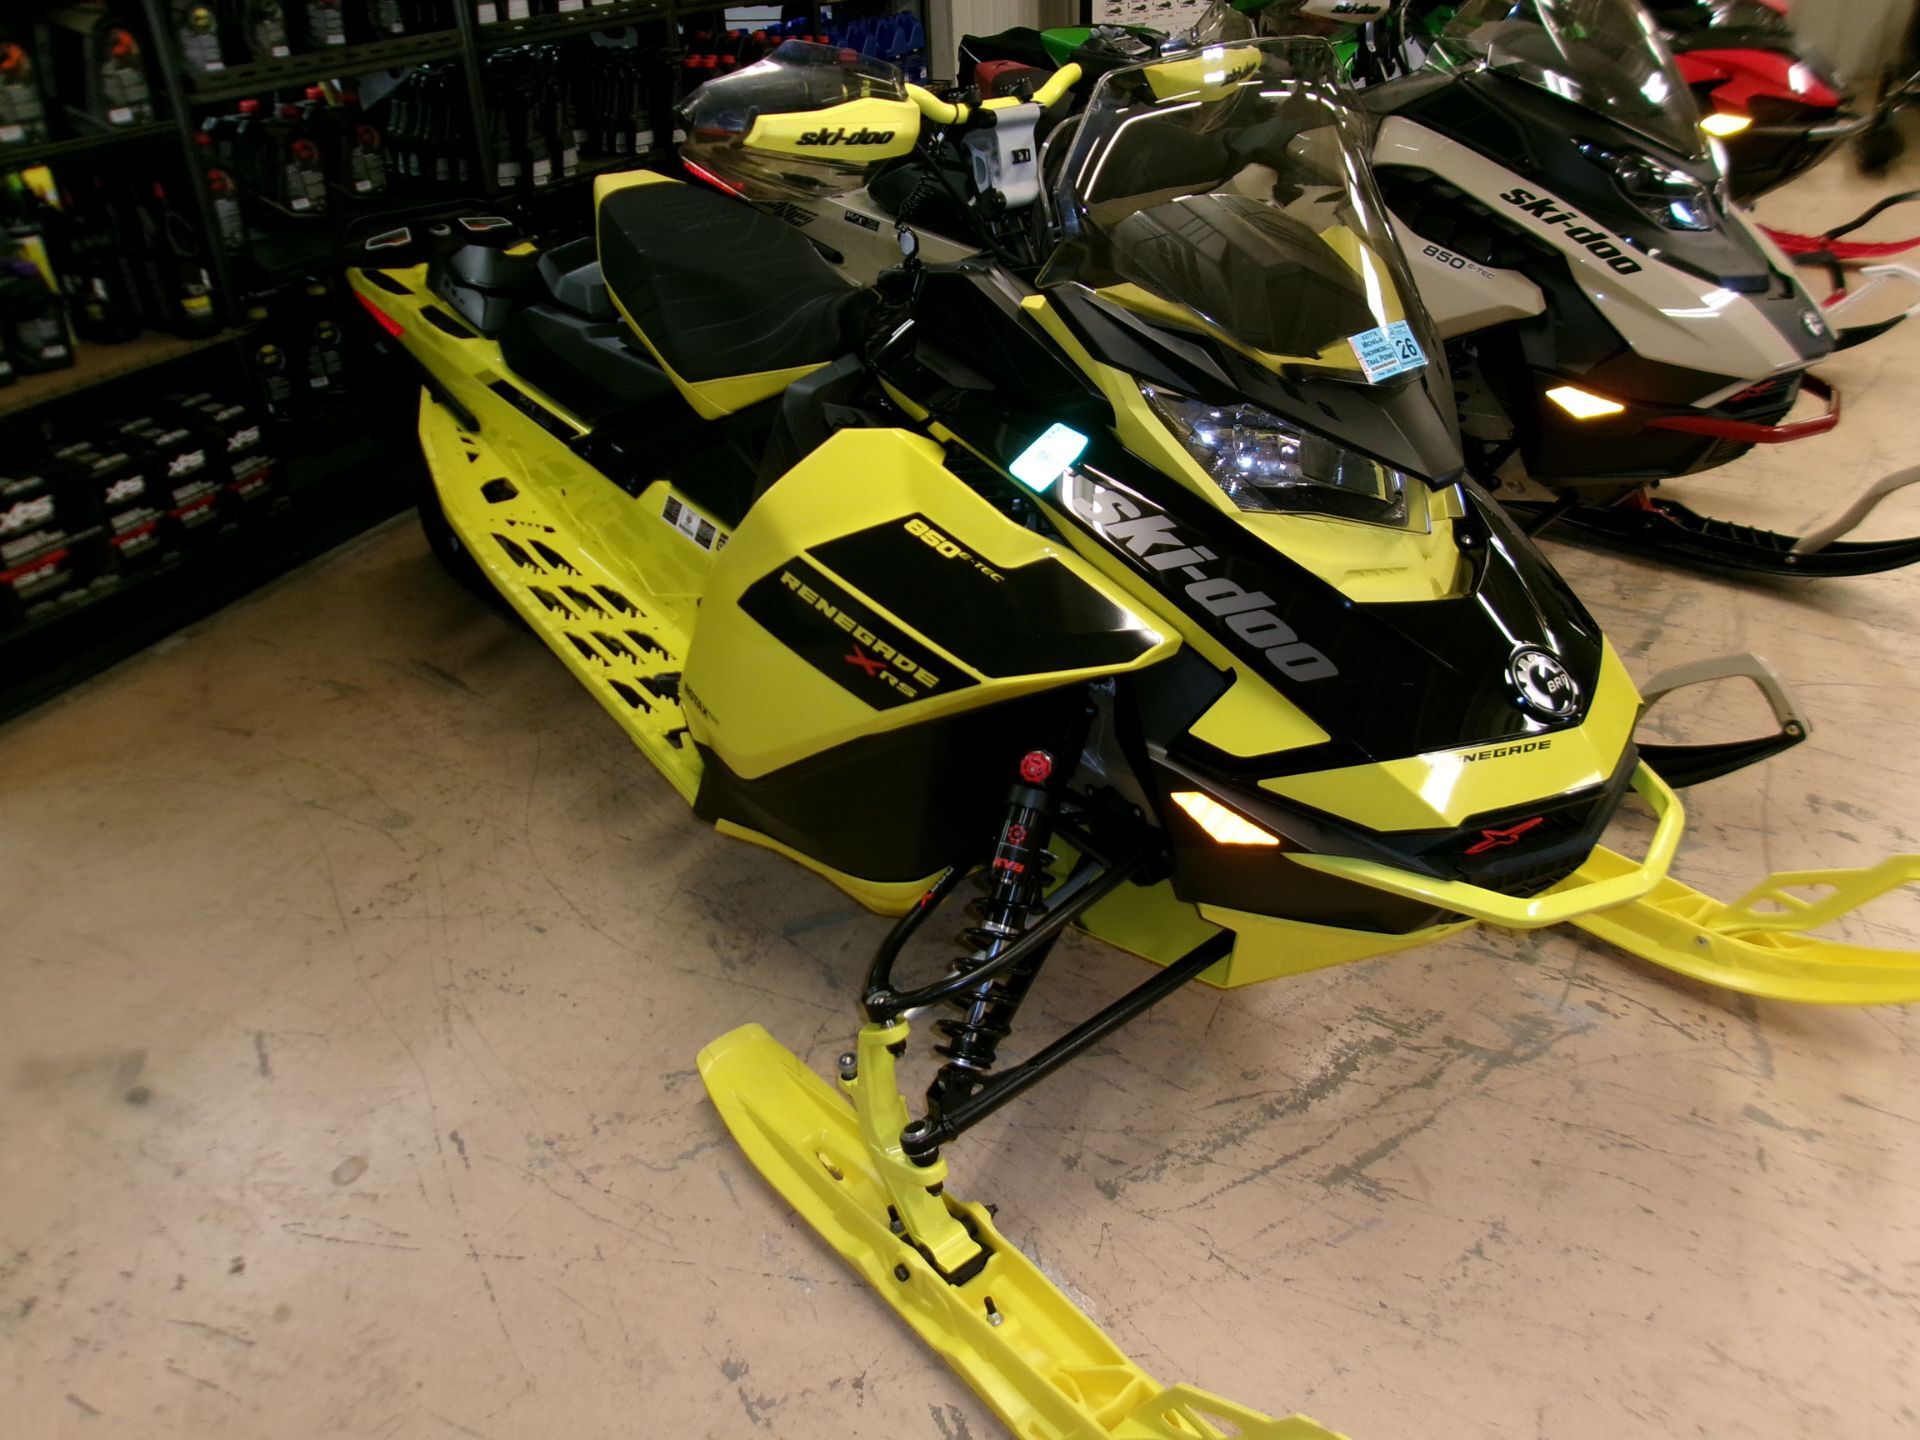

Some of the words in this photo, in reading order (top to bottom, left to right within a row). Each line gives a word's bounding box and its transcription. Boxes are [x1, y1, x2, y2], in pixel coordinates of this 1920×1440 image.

[795, 126, 895, 146] ski-doo
[1500, 187, 1643, 276] ski-doo
[1423, 245, 1466, 270] 850
[1467, 263, 1496, 280] E-TEC
[1396, 338, 1417, 359] 26
[903, 518, 962, 559] 850
[958, 551, 1006, 583] E-TEC
[1072, 489, 1338, 682] ski-doo
[780, 571, 940, 689] RENEGADE
[879, 671, 919, 699] RS
[1546, 673, 1567, 694] BRP
[1460, 739, 1552, 764] NEGADE
